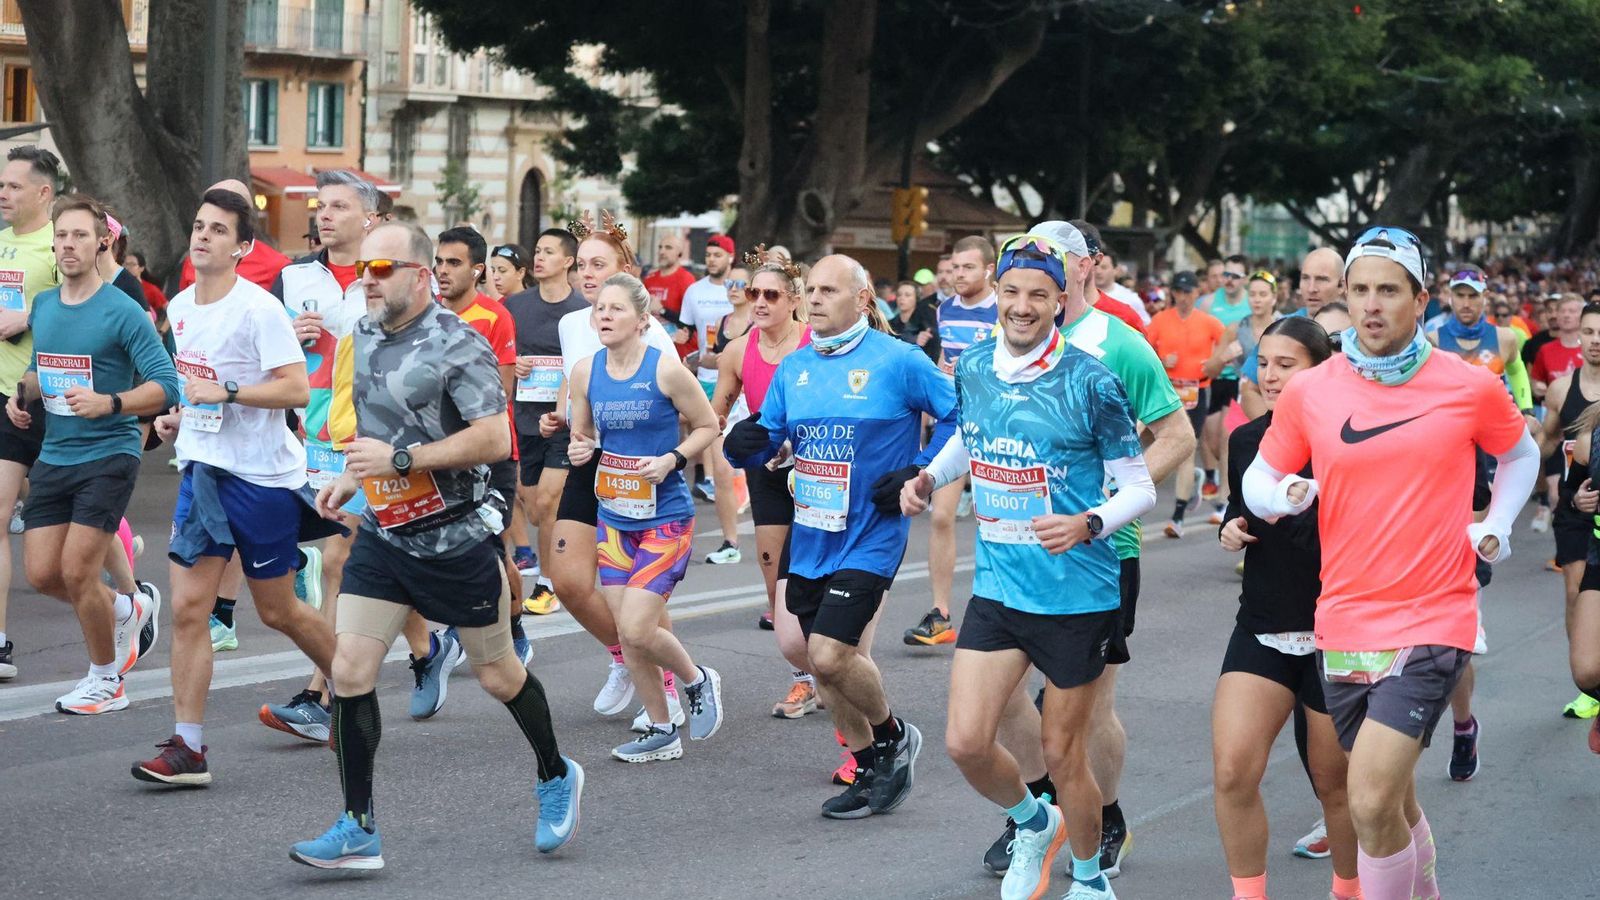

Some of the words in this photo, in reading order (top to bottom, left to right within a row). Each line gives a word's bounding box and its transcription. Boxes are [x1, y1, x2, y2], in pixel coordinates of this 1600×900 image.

[0, 271, 21, 282] ERALI
[0, 290, 14, 302] 67
[48, 355, 87, 368] GENERALI
[532, 358, 563, 367] GENERAL
[604, 399, 653, 410] BENTLEY
[601, 410, 650, 421] RUNNING
[606, 420, 634, 430] CLUB
[832, 424, 855, 440] DE
[983, 436, 1036, 459] MEDIA
[312, 450, 339, 464] 13619
[801, 462, 843, 477] GENERALI
[986, 467, 1039, 484] GENERALI
[372, 477, 410, 495] 7420
[605, 475, 641, 491] 14380
[800, 482, 832, 500] 12766
[984, 491, 1029, 511] 16007
